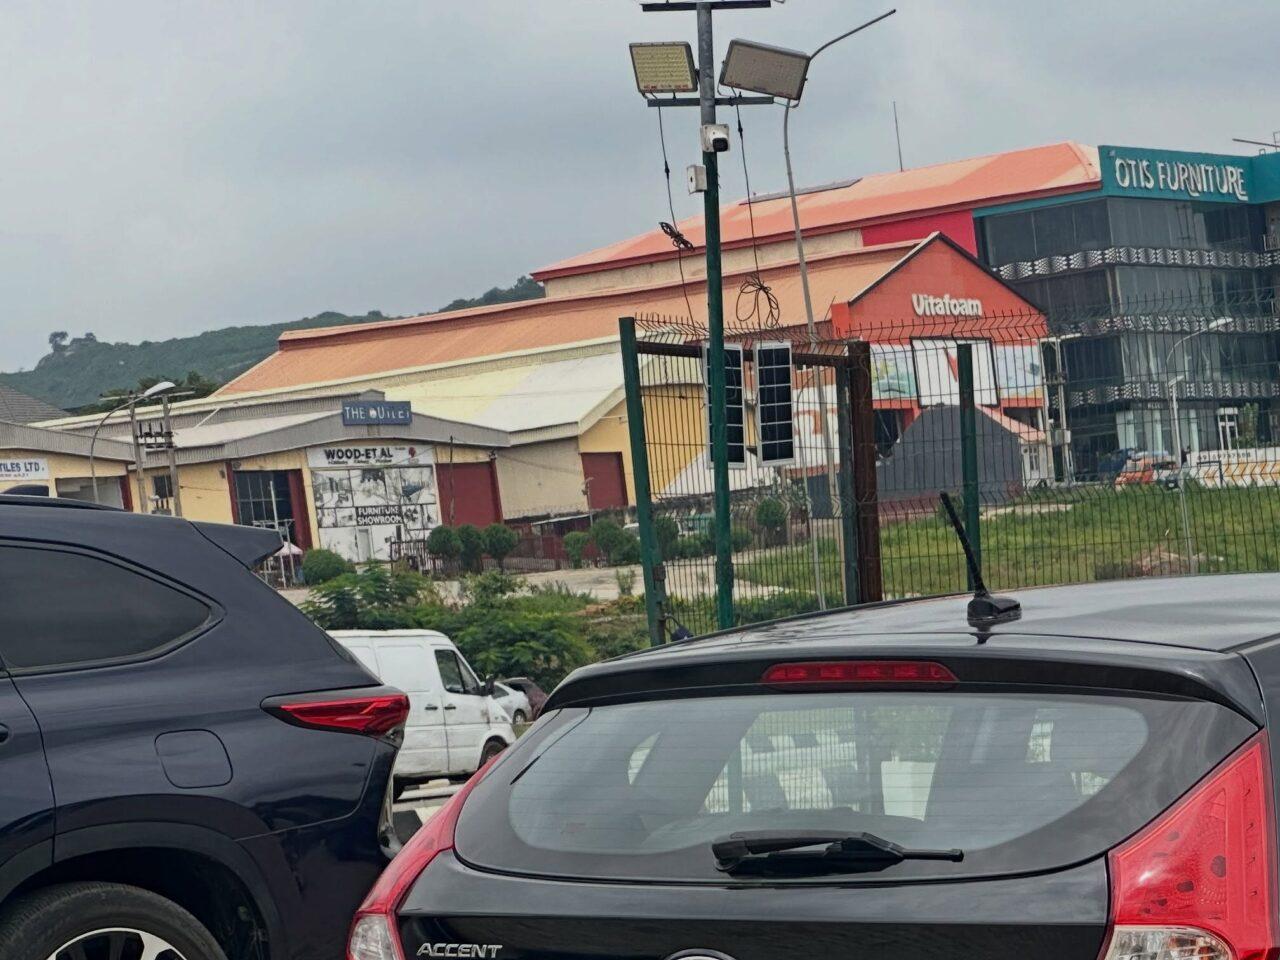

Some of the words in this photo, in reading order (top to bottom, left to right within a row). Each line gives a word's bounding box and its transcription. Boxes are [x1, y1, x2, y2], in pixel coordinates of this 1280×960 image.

[1115, 157, 1155, 189] OTIS
[1156, 160, 1249, 201] FURNITURE
[911, 293, 983, 316] Vitafoam
[344, 406, 367, 420] THE
[358, 505, 401, 516] FURNITURE
[357, 514, 402, 526] SHOWROOM
[416, 942, 503, 959] ACCENT
